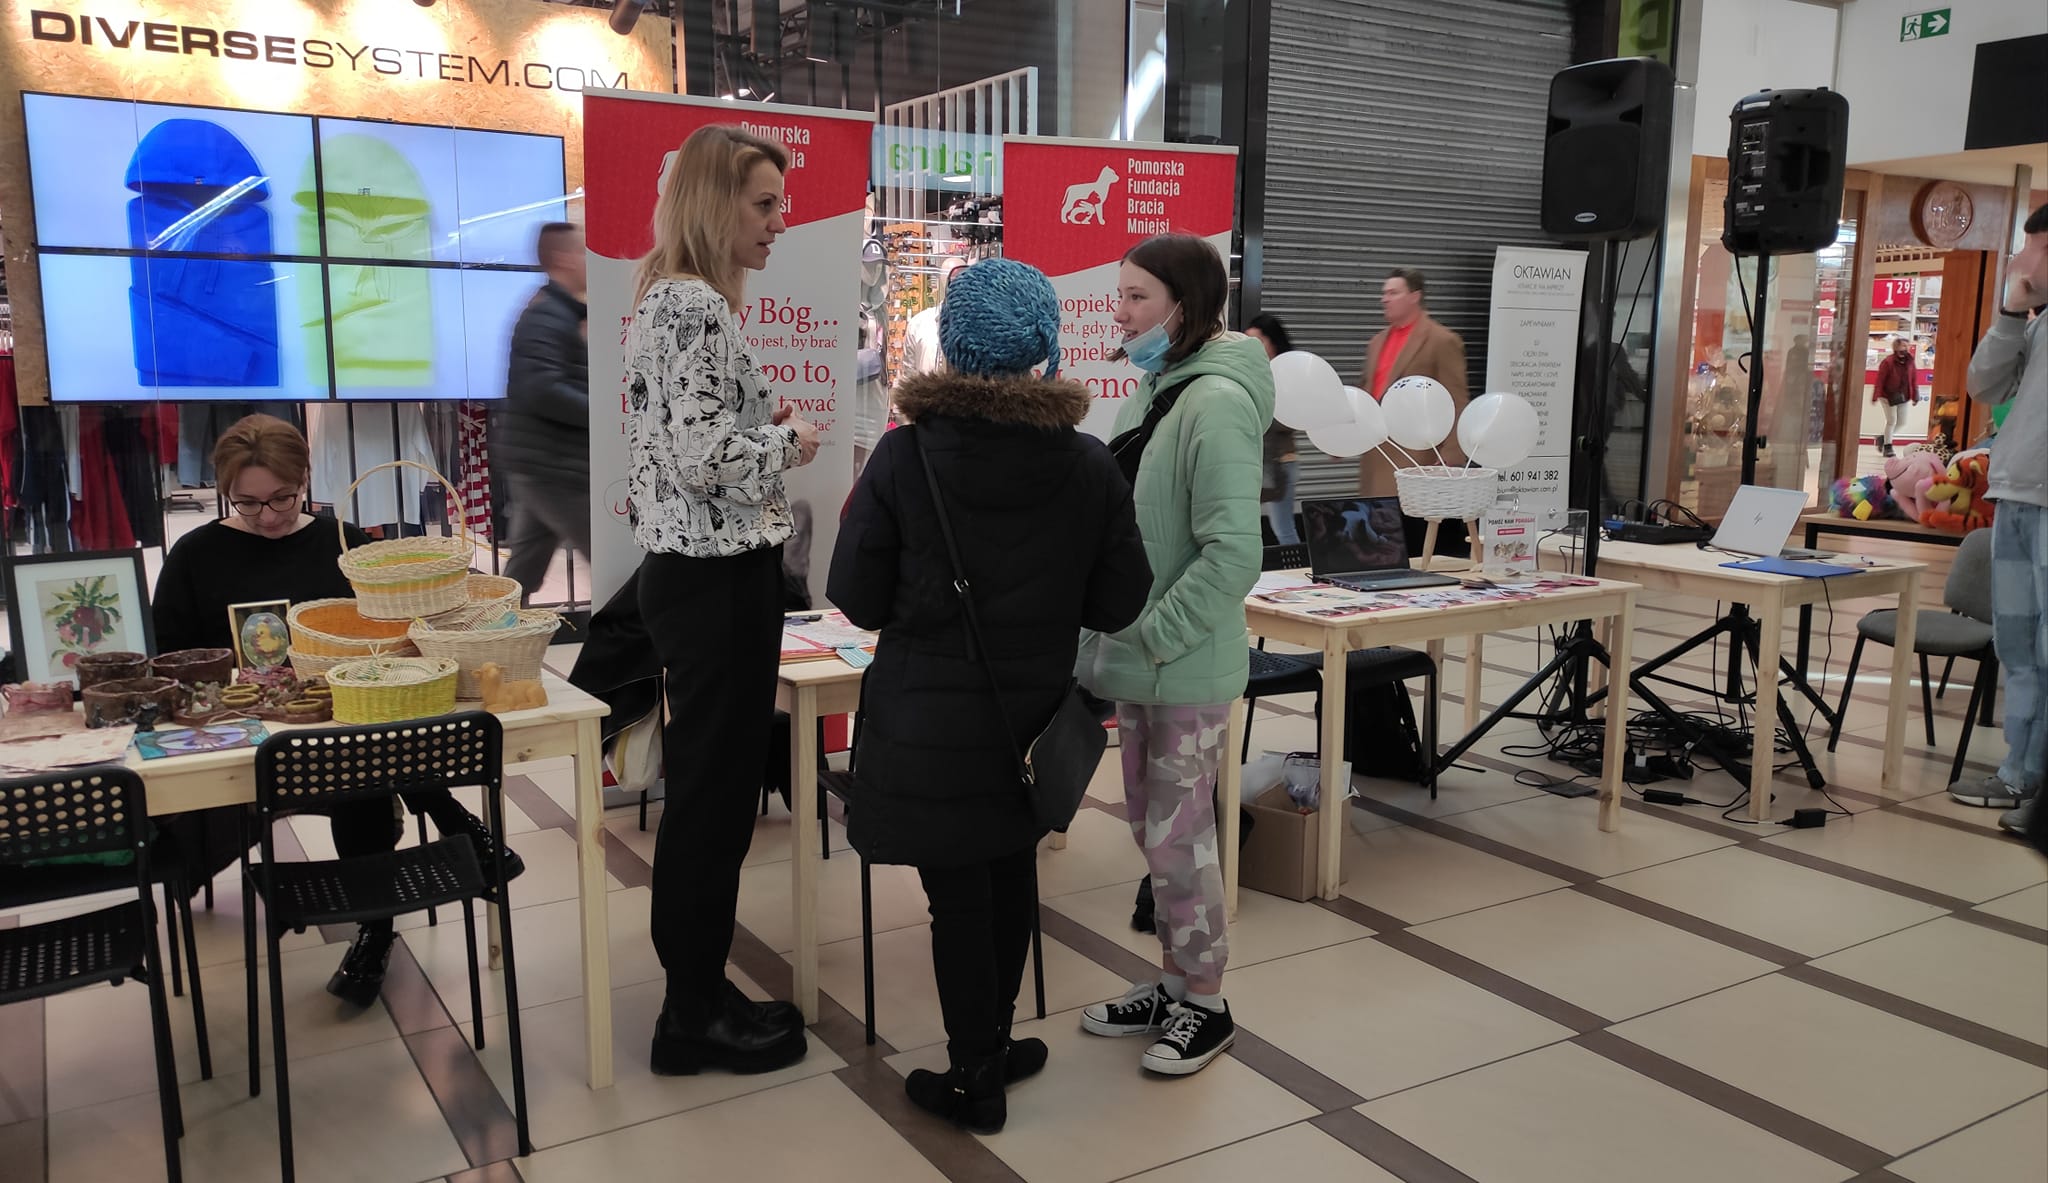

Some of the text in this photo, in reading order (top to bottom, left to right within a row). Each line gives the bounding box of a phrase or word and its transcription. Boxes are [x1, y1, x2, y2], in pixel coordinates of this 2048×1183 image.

[1127, 157, 1185, 176] Pomorska
[1127, 178, 1181, 197] Fundacja
[1127, 198, 1165, 215] Bracia
[1127, 218, 1170, 236] Mniejsi
[1513, 264, 1571, 280] OKTAWIAN
[1082, 321, 1107, 339] gdy
[761, 335, 788, 350] jest,
[791, 334, 807, 351] by
[810, 335, 837, 348] brać
[804, 360, 837, 389] to,
[1497, 470, 1559, 482] tel. 601 941 382
